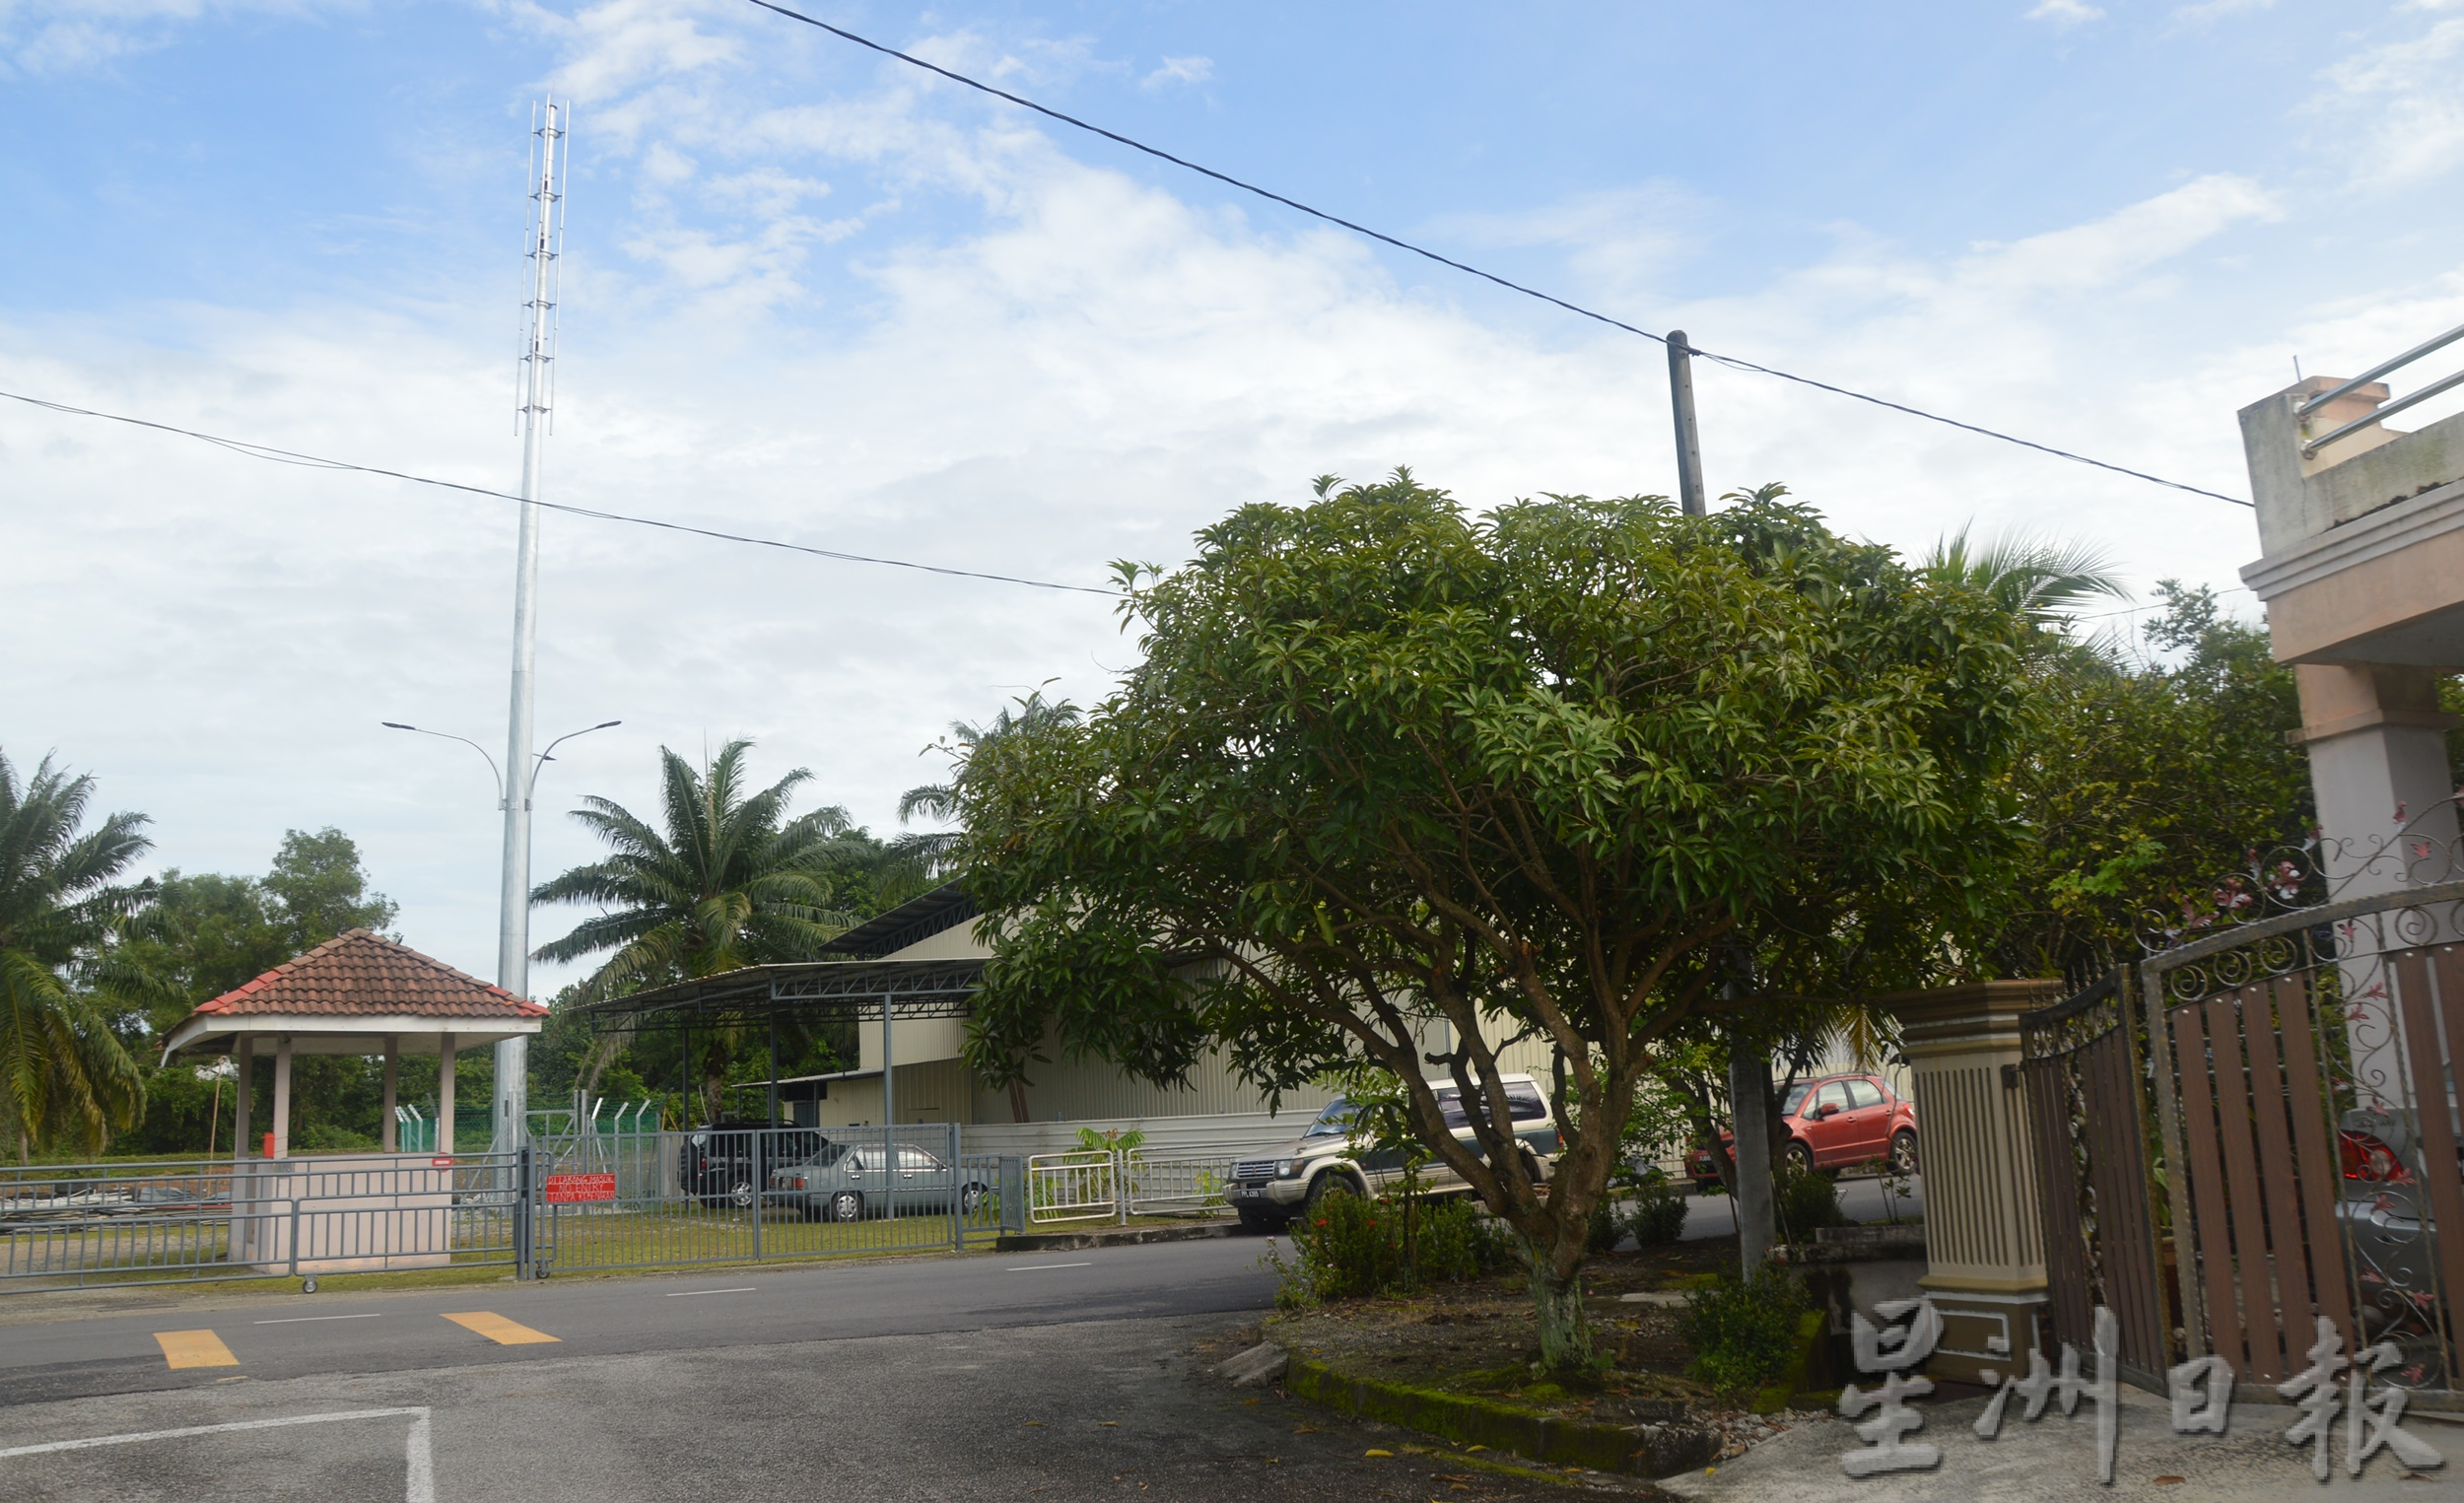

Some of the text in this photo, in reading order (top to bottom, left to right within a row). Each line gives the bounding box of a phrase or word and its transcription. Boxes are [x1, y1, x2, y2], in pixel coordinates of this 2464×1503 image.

[559, 1175, 588, 1184] LARANG
[559, 1183, 604, 1193] NO ENTRY
[548, 1192, 576, 1202] TANPA
